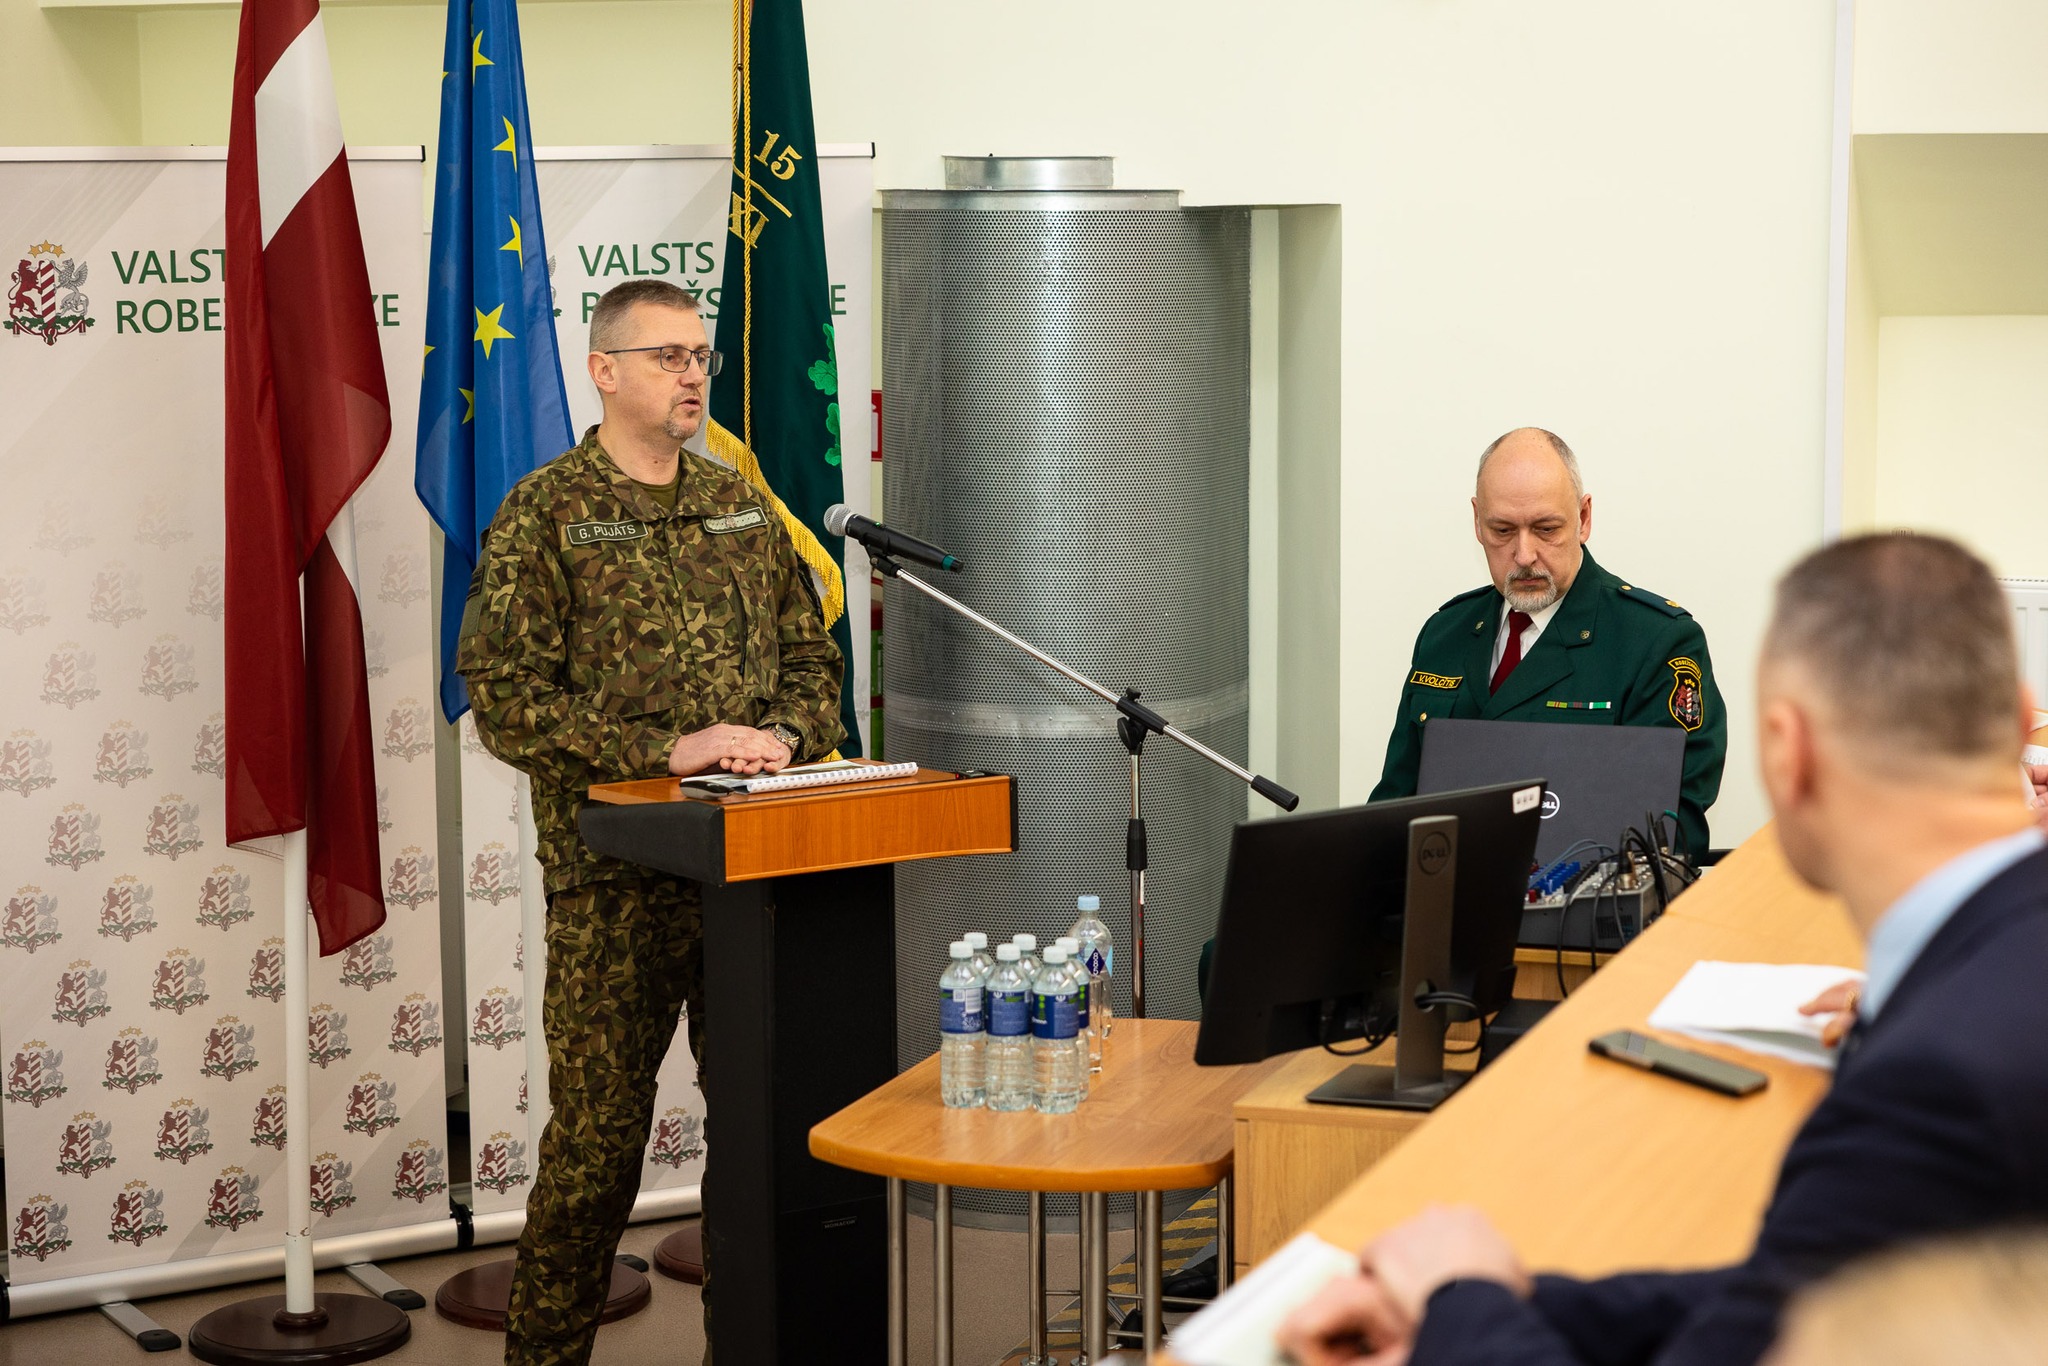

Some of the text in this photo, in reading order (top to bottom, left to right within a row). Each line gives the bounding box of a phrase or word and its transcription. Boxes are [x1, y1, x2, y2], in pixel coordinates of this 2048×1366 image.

[753, 129, 802, 180] 15
[111, 248, 226, 284] VALST
[577, 242, 715, 277] VALSTS
[579, 524, 636, 539] G. PUJĀTS
